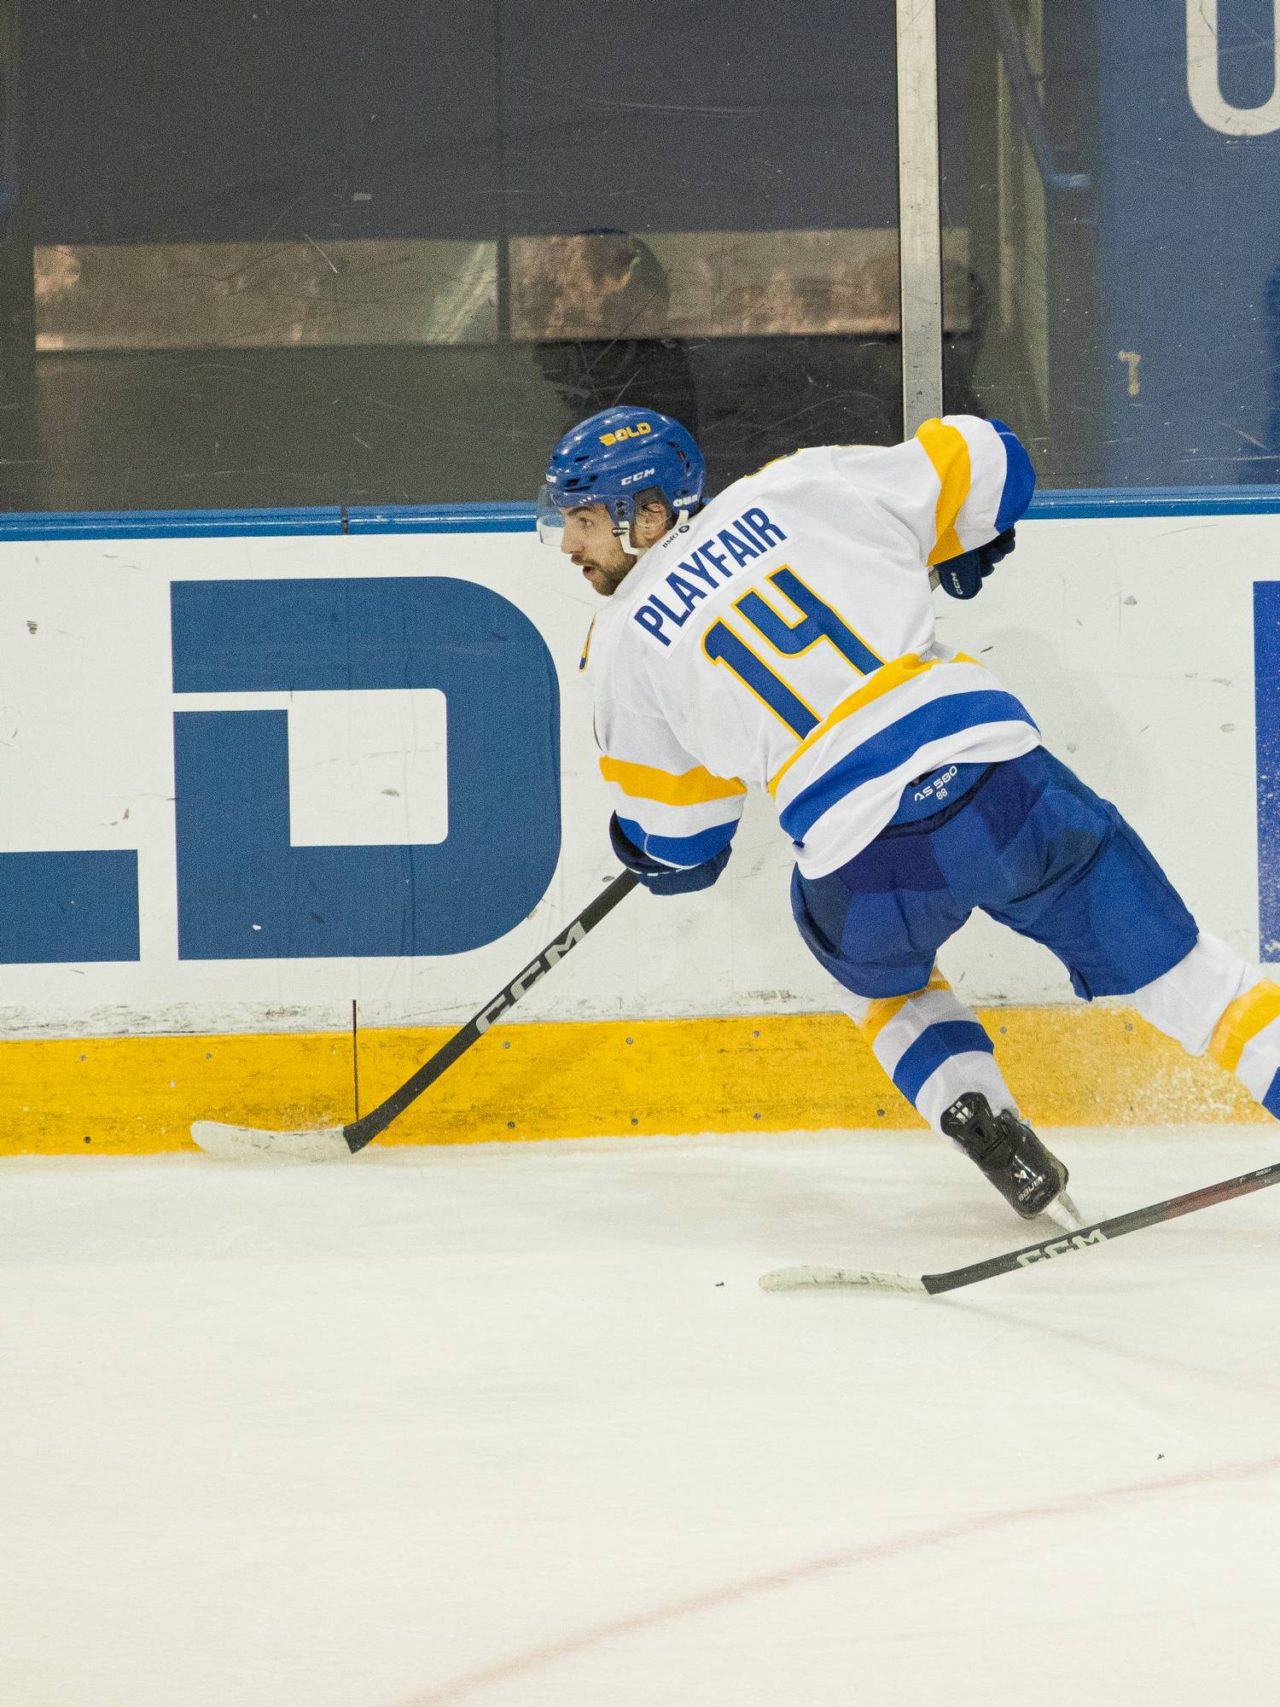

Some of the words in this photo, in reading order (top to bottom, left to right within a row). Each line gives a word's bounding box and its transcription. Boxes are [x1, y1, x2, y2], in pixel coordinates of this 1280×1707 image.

[620, 468, 655, 486] CCM
[633, 507, 787, 648] PLAYFAIR
[701, 564, 889, 742] 14
[914, 786, 934, 801] AS
[933, 765, 958, 790] 580
[475, 920, 587, 1035] CCM
[1016, 1228, 1108, 1267] CCM
